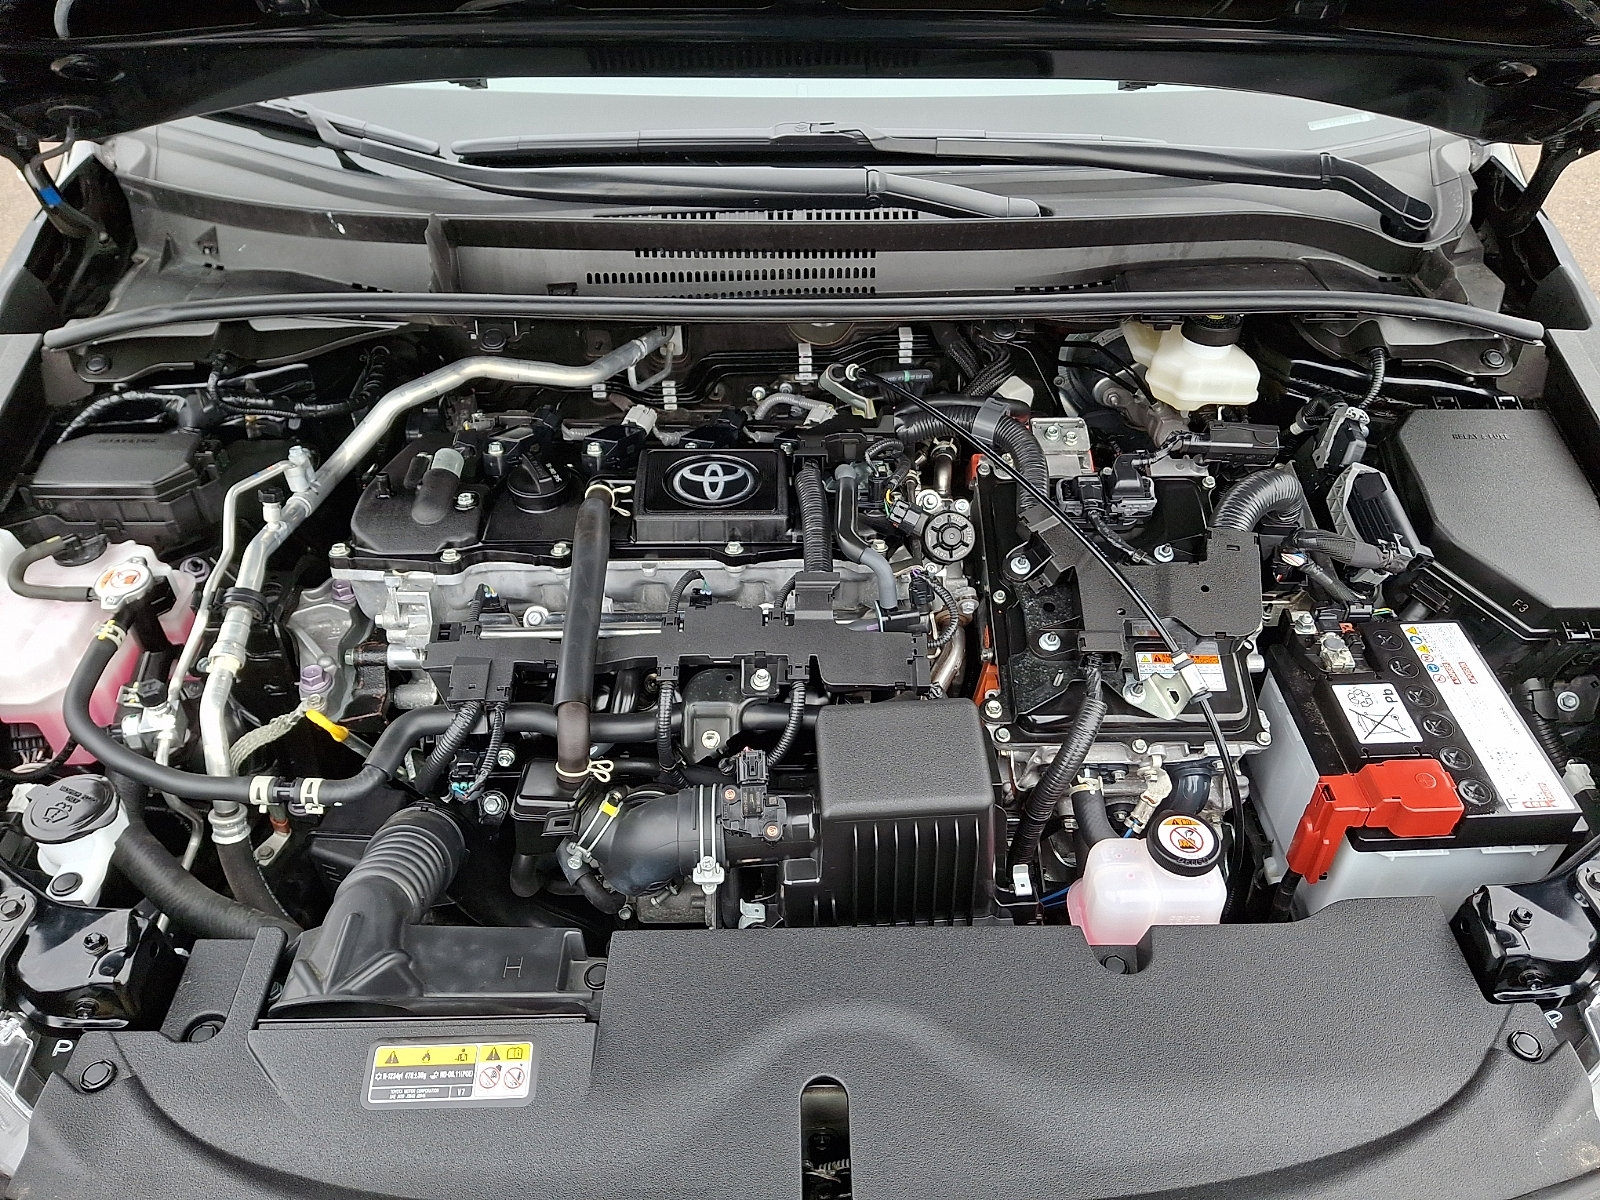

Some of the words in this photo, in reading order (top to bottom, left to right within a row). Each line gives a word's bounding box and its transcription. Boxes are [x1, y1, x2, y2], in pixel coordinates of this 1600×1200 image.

[1512, 598, 1529, 613] F3
[1383, 688, 1398, 702] Pb
[502, 956, 524, 978] H
[1544, 1010, 1563, 1029] P
[52, 1040, 73, 1057] P
